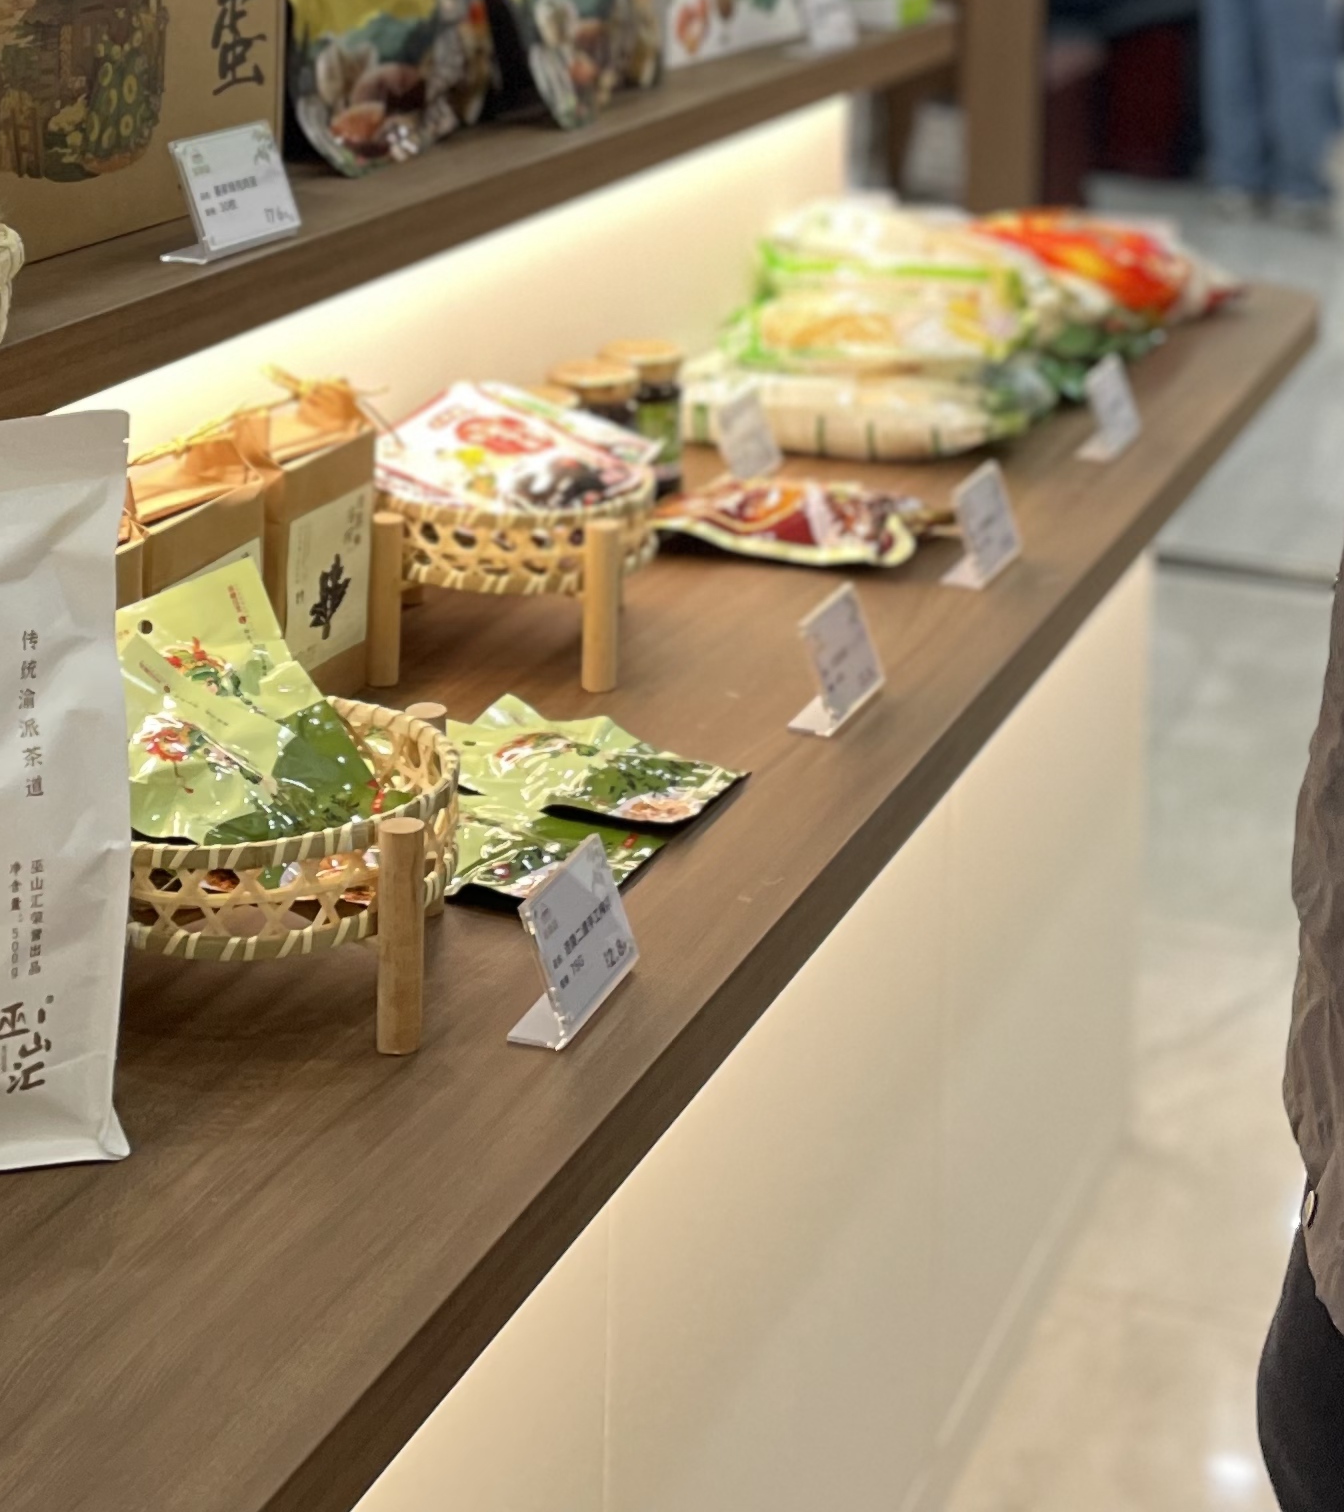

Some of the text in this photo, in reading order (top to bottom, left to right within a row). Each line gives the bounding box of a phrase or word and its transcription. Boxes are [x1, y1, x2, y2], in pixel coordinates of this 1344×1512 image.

[18, 629, 44, 797] 传统渝派茶道
